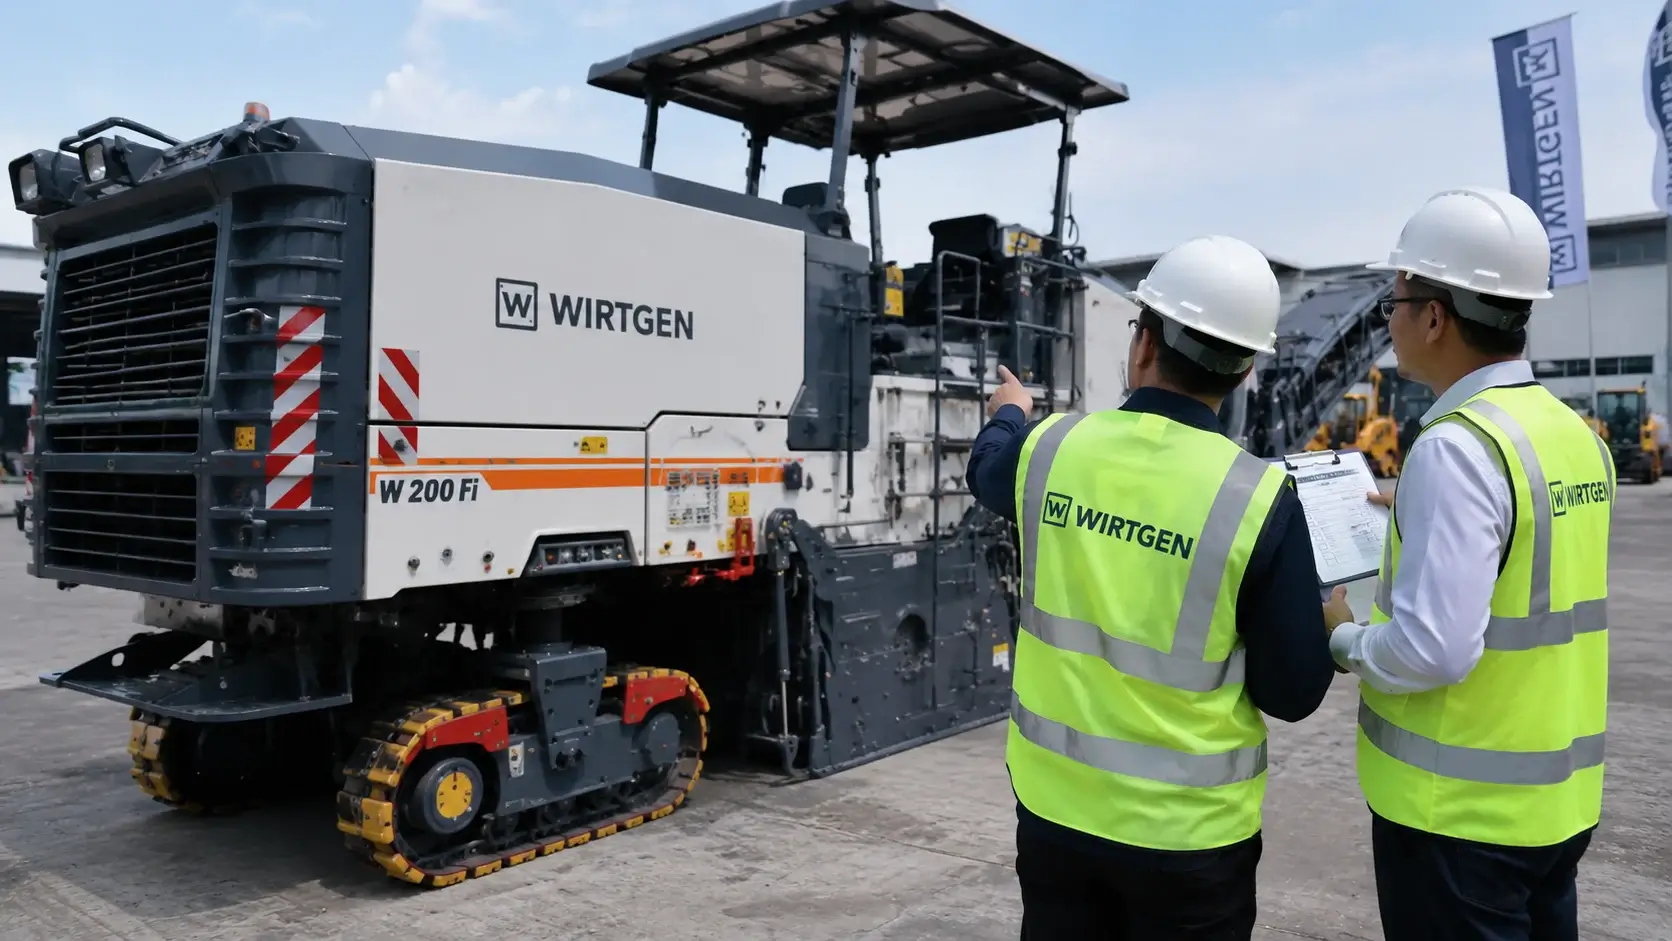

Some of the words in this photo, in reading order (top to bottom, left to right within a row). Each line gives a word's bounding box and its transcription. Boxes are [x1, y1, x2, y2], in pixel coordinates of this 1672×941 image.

[549, 293, 693, 340] WIRTGEN
[380, 480, 404, 504] W
[407, 479, 455, 503] 200
[459, 478, 479, 502] Fi
[1564, 481, 1609, 508] WIRTGEN
[1076, 505, 1194, 560] WIRTGEN
